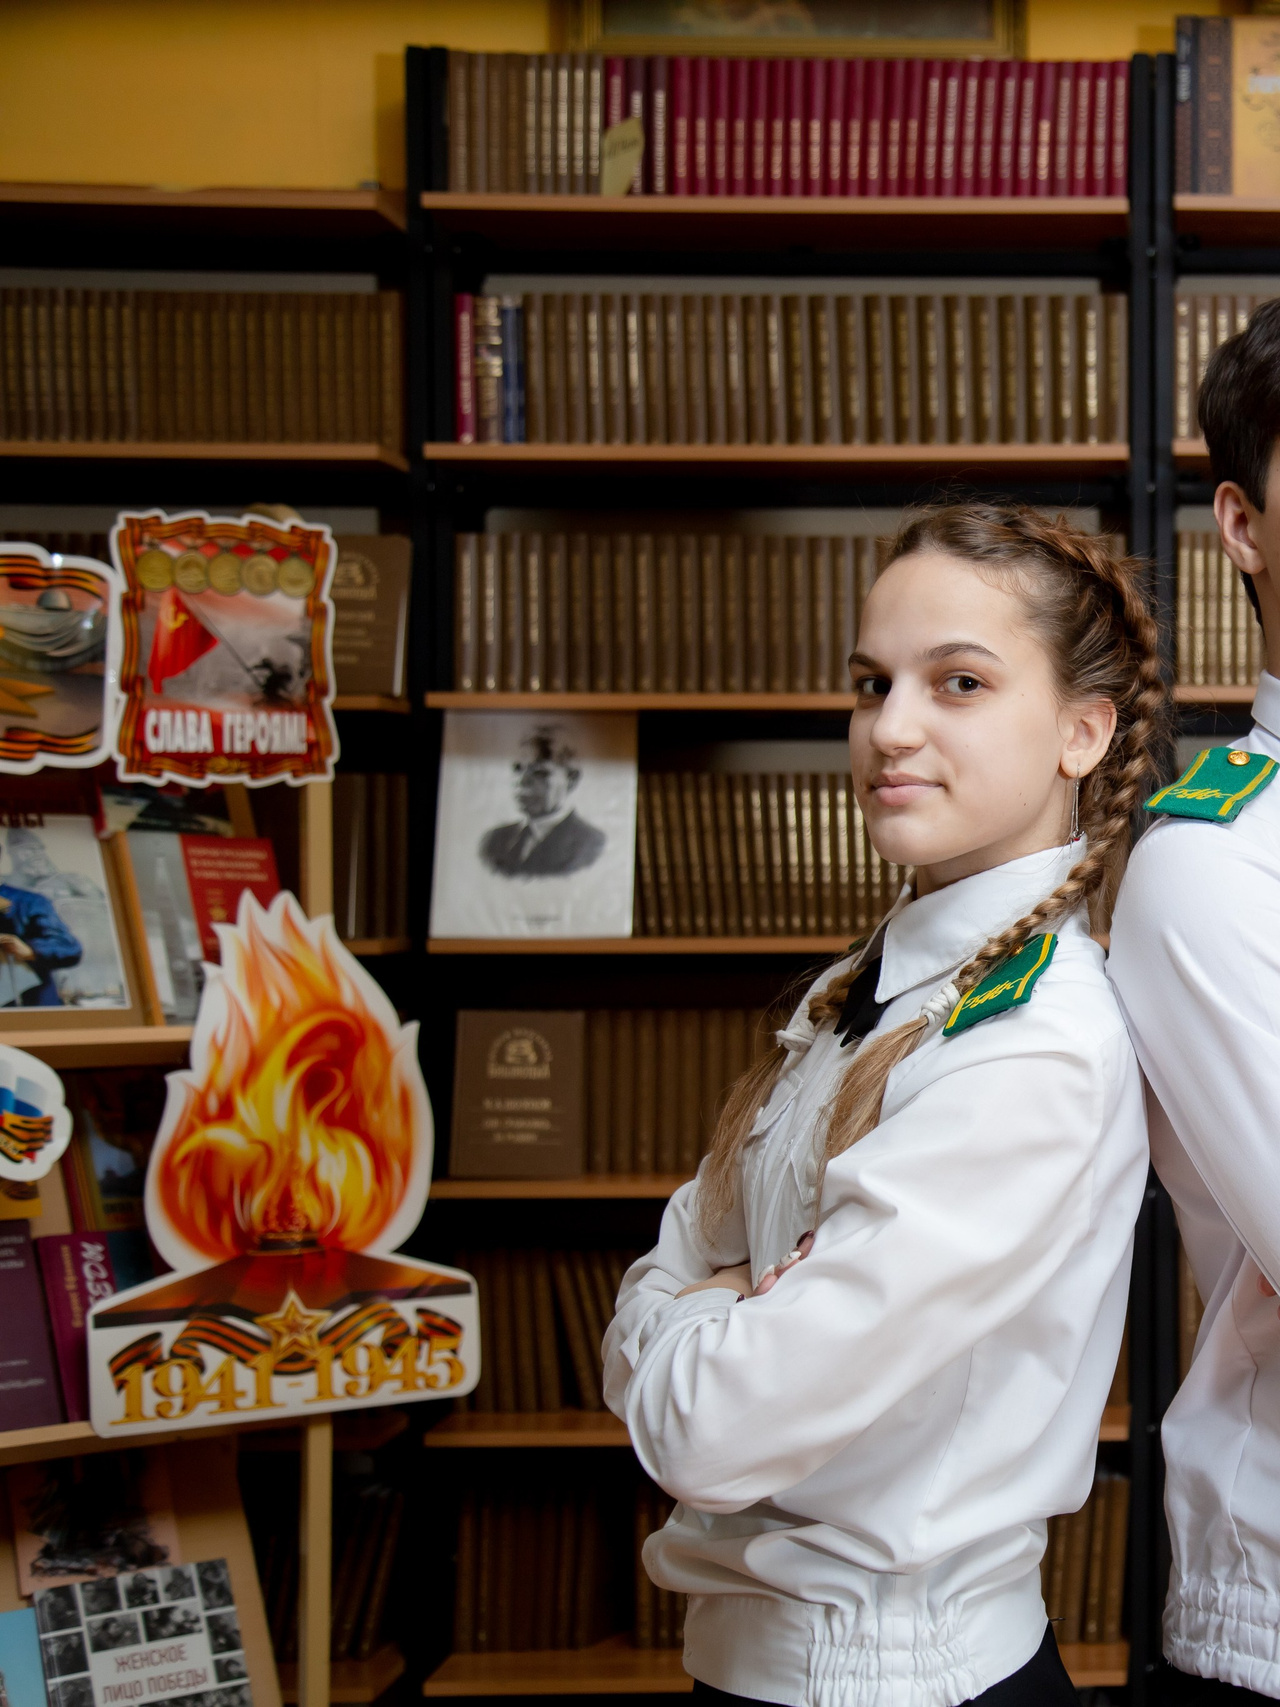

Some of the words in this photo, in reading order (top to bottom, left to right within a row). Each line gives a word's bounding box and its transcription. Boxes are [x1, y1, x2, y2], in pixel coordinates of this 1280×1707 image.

[144, 710, 214, 754] СЛАВА
[222, 711, 309, 756] ГЕРОЯМ!
[114, 1642, 188, 1673] ЖЕНСКОЕ
[103, 1680, 144, 1704] ЛИЦО
[147, 1667, 209, 1694] ПОБЕДЫ
